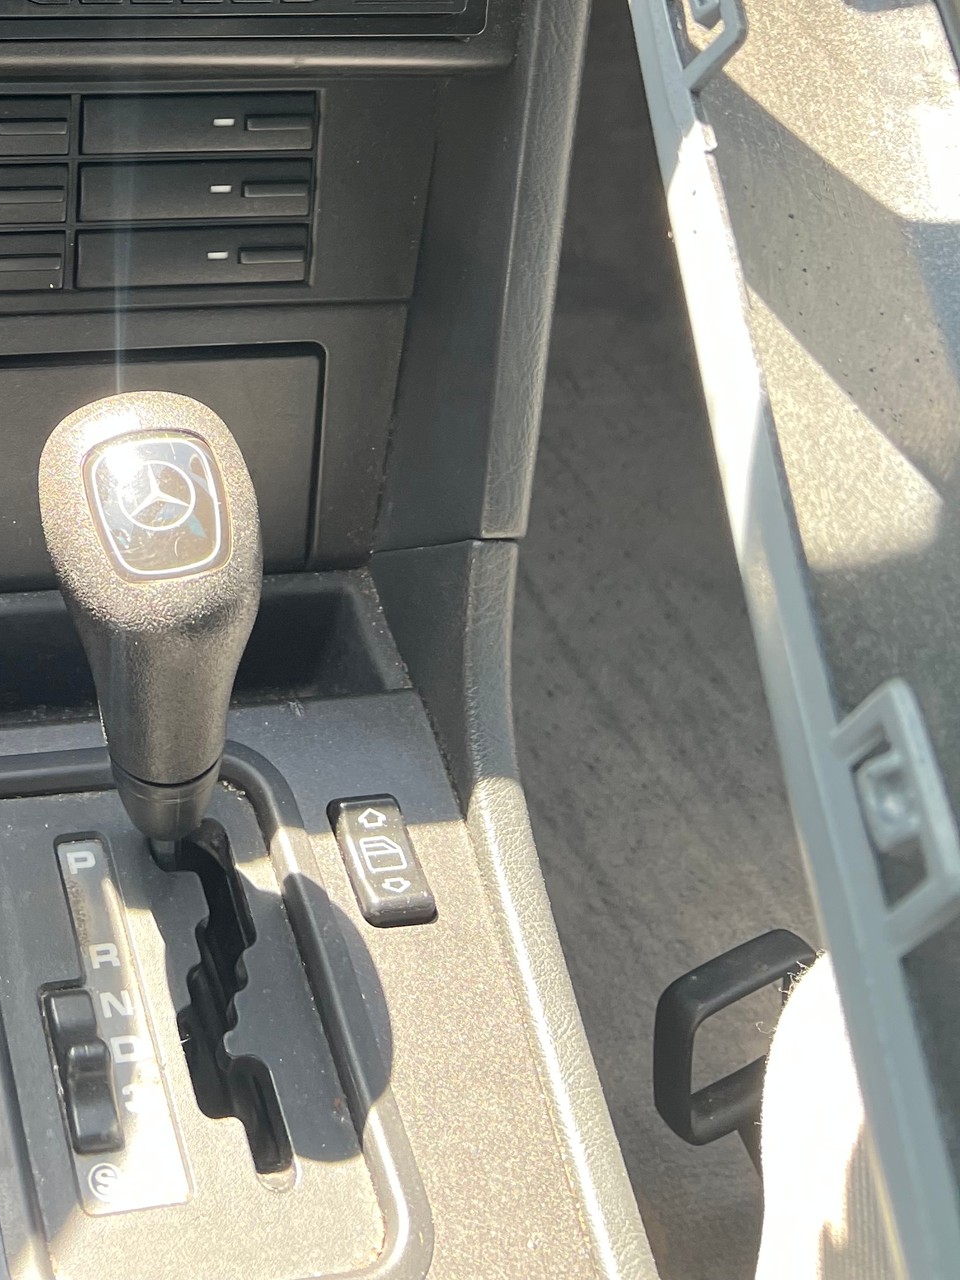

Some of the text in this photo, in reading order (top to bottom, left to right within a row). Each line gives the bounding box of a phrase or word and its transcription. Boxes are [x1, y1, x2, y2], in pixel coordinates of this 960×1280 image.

[66, 851, 96, 875] P
[88, 942, 120, 969] R
[98, 991, 135, 1018] N
[110, 1036, 141, 1064] D
